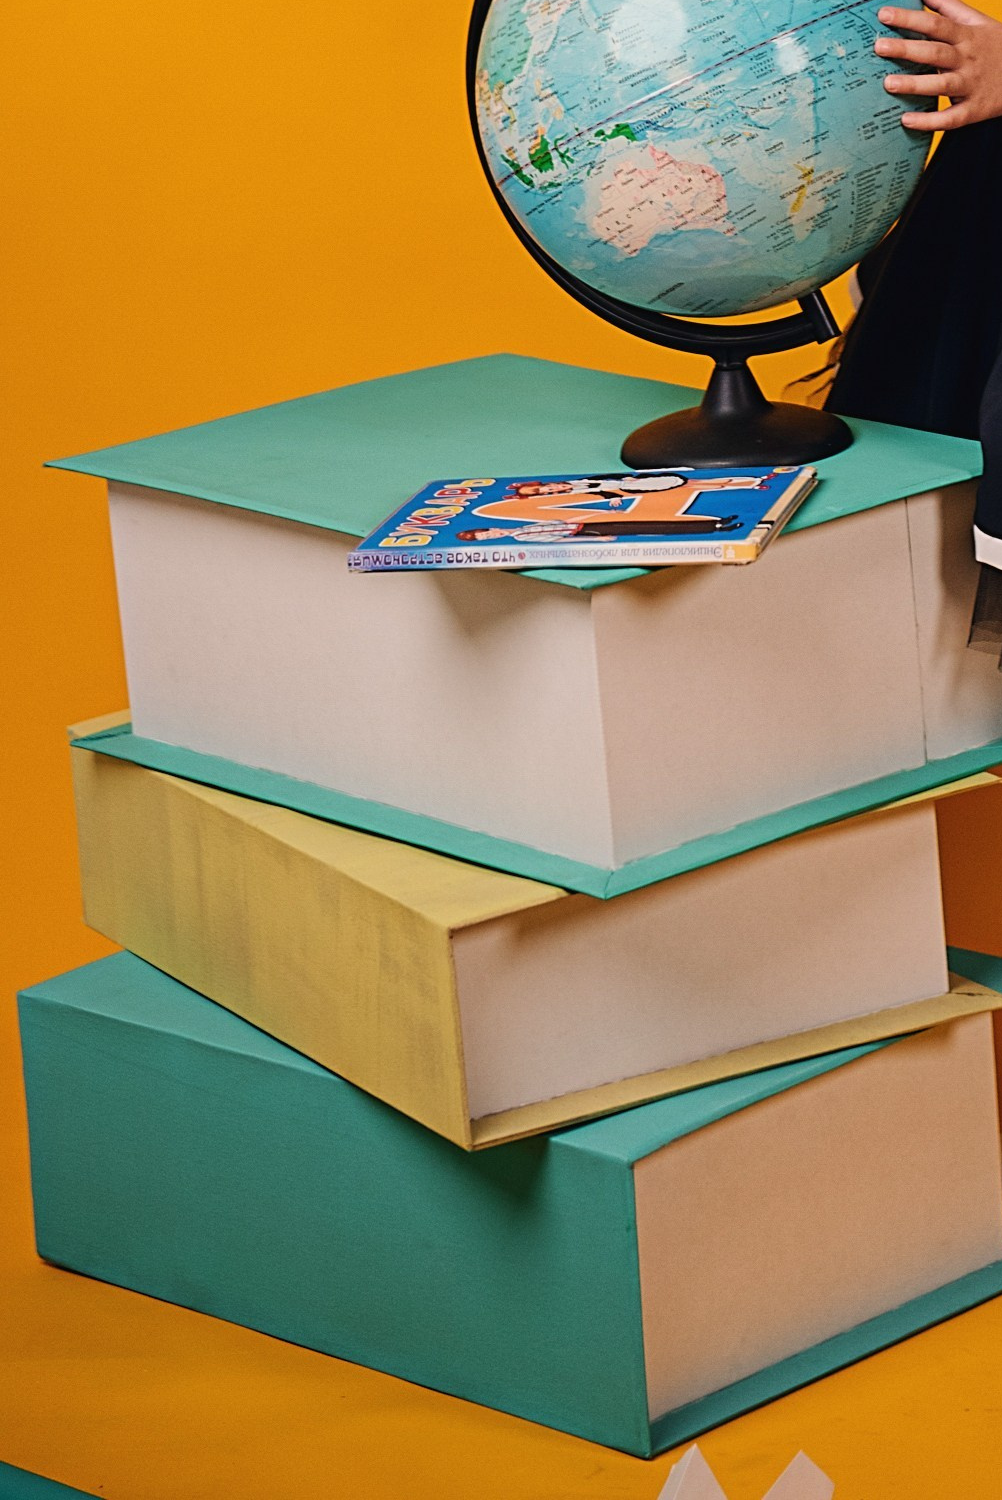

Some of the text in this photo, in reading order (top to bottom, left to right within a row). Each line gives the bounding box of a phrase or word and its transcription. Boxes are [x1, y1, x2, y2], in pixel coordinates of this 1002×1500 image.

[378, 478, 496, 547] БУКВАРЬ
[621, 547, 640, 558] для
[642, 546, 722, 558] Энциклопедия
